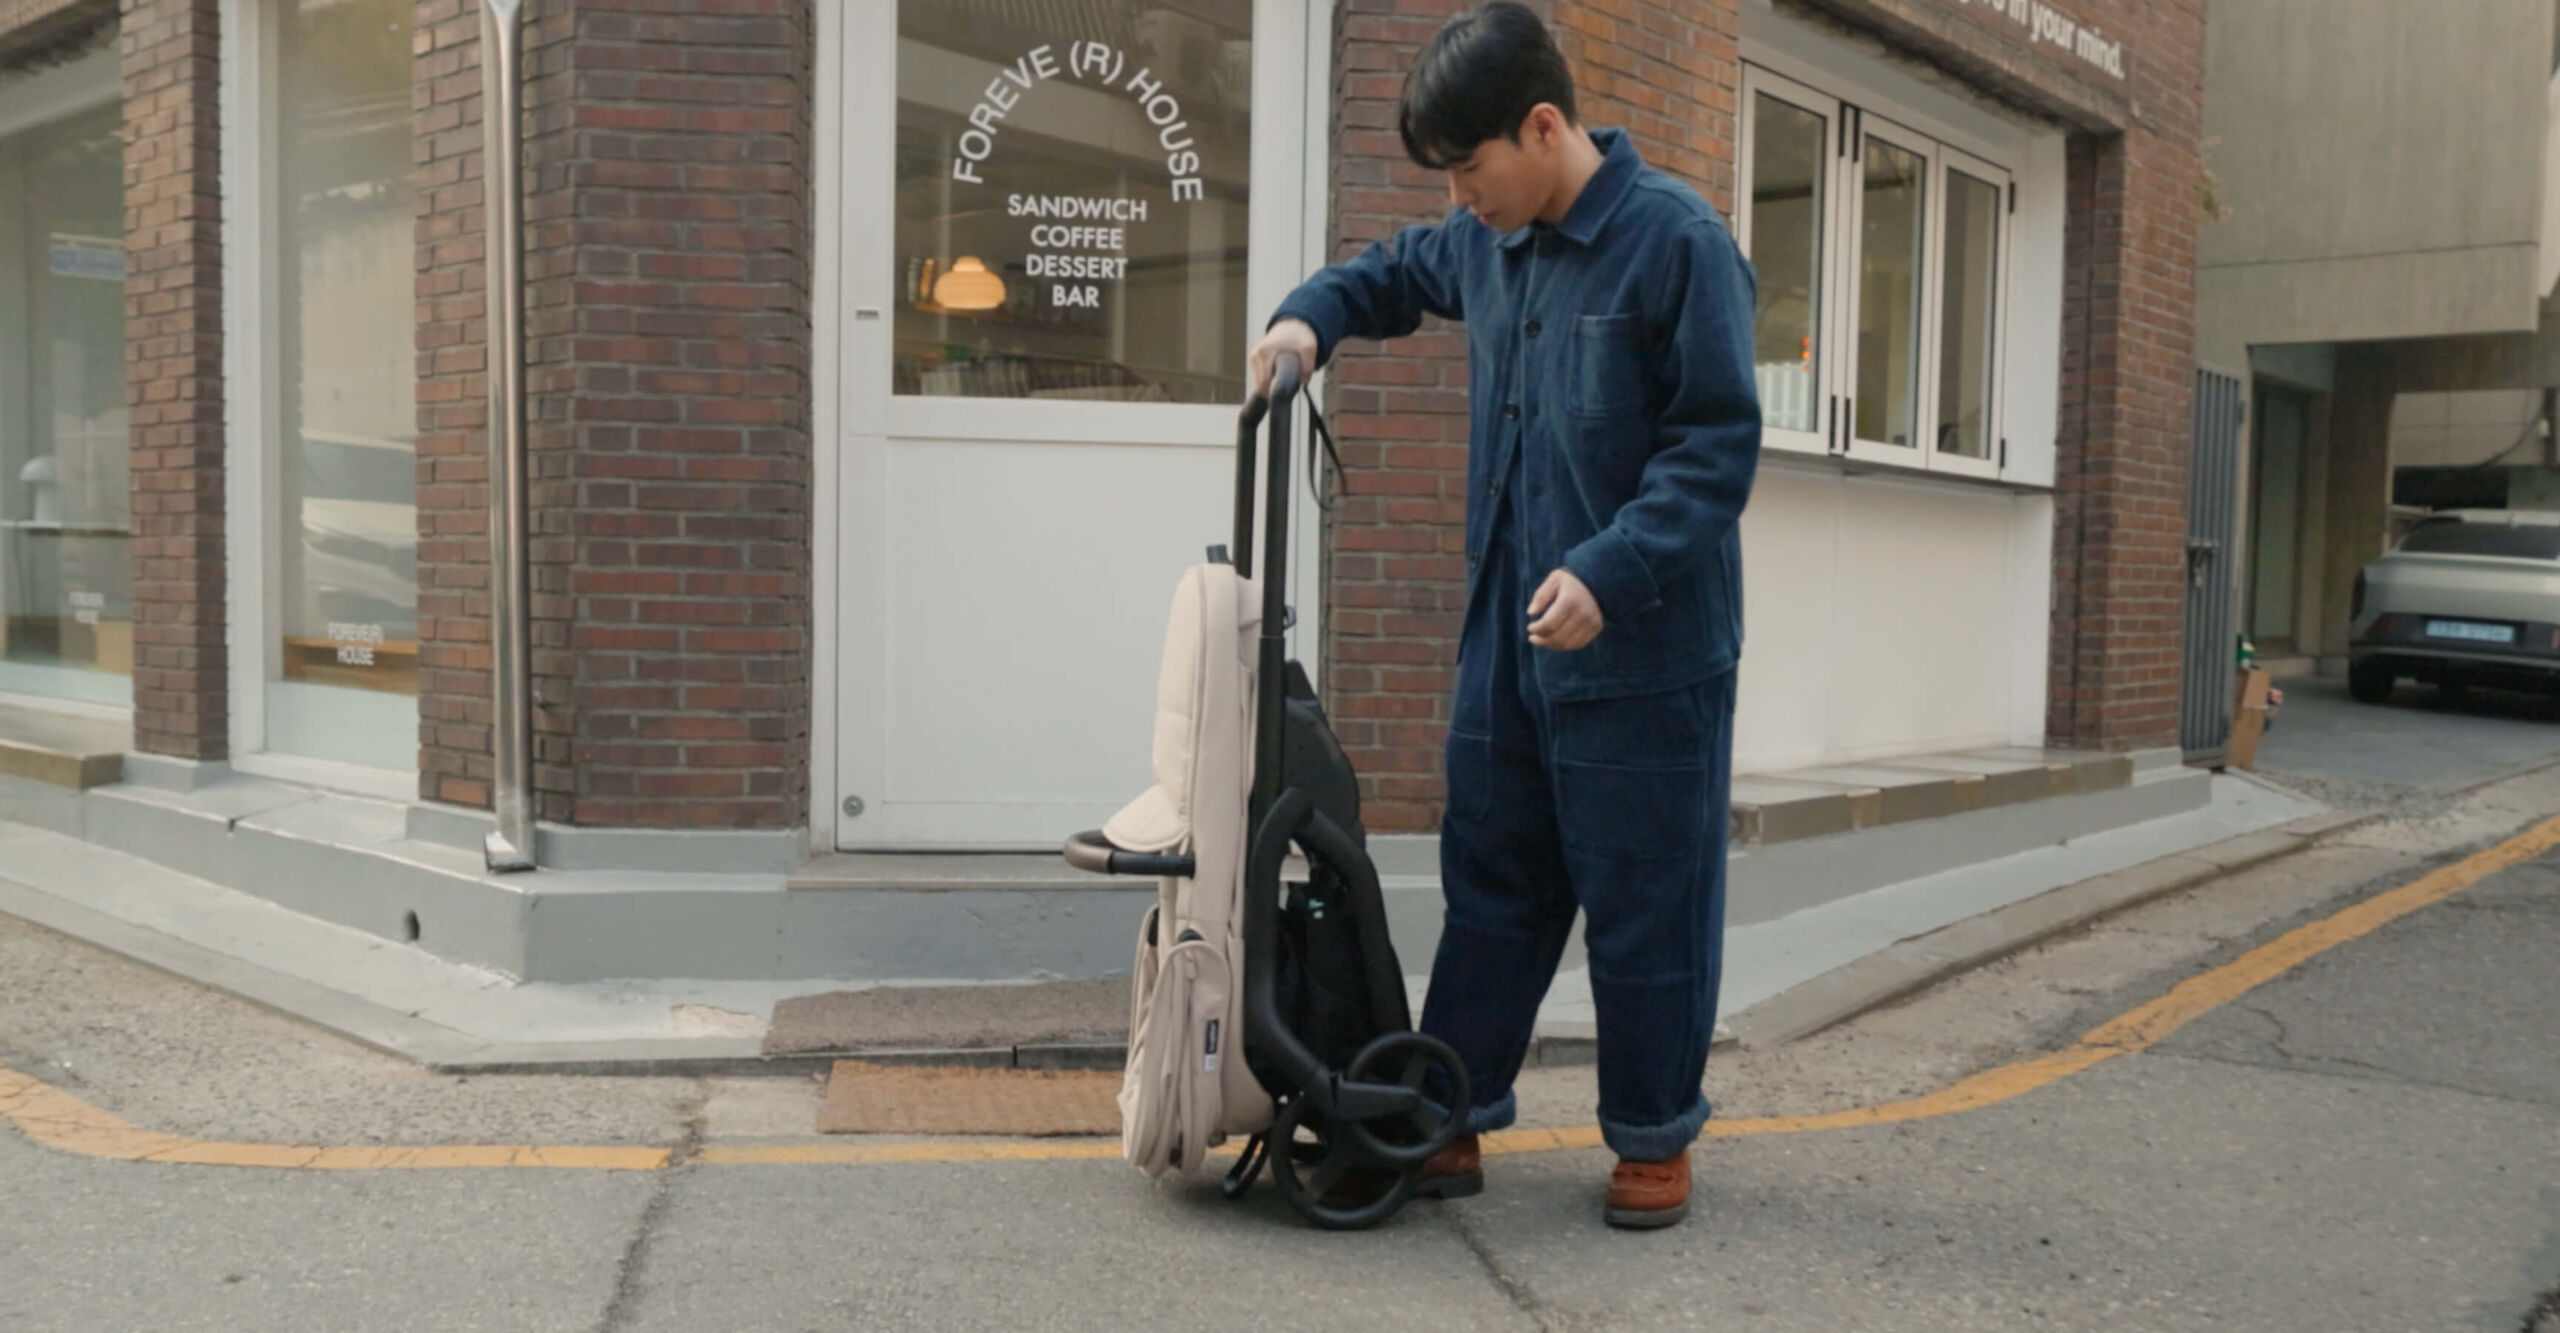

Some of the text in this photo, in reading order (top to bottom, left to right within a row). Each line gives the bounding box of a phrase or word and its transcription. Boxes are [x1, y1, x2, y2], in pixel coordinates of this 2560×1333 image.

[2030, 1, 2075, 50] your
[2076, 27, 2125, 80] mind.
[953, 40, 1204, 202] FOREVE (R) HOUSE
[1007, 194, 1147, 221] SANDWICH
[1030, 224, 1123, 249] COFFEE
[1026, 255, 1128, 279] DESSERT
[1052, 284, 1099, 308] BAR
[337, 646, 374, 666] HOUSE
